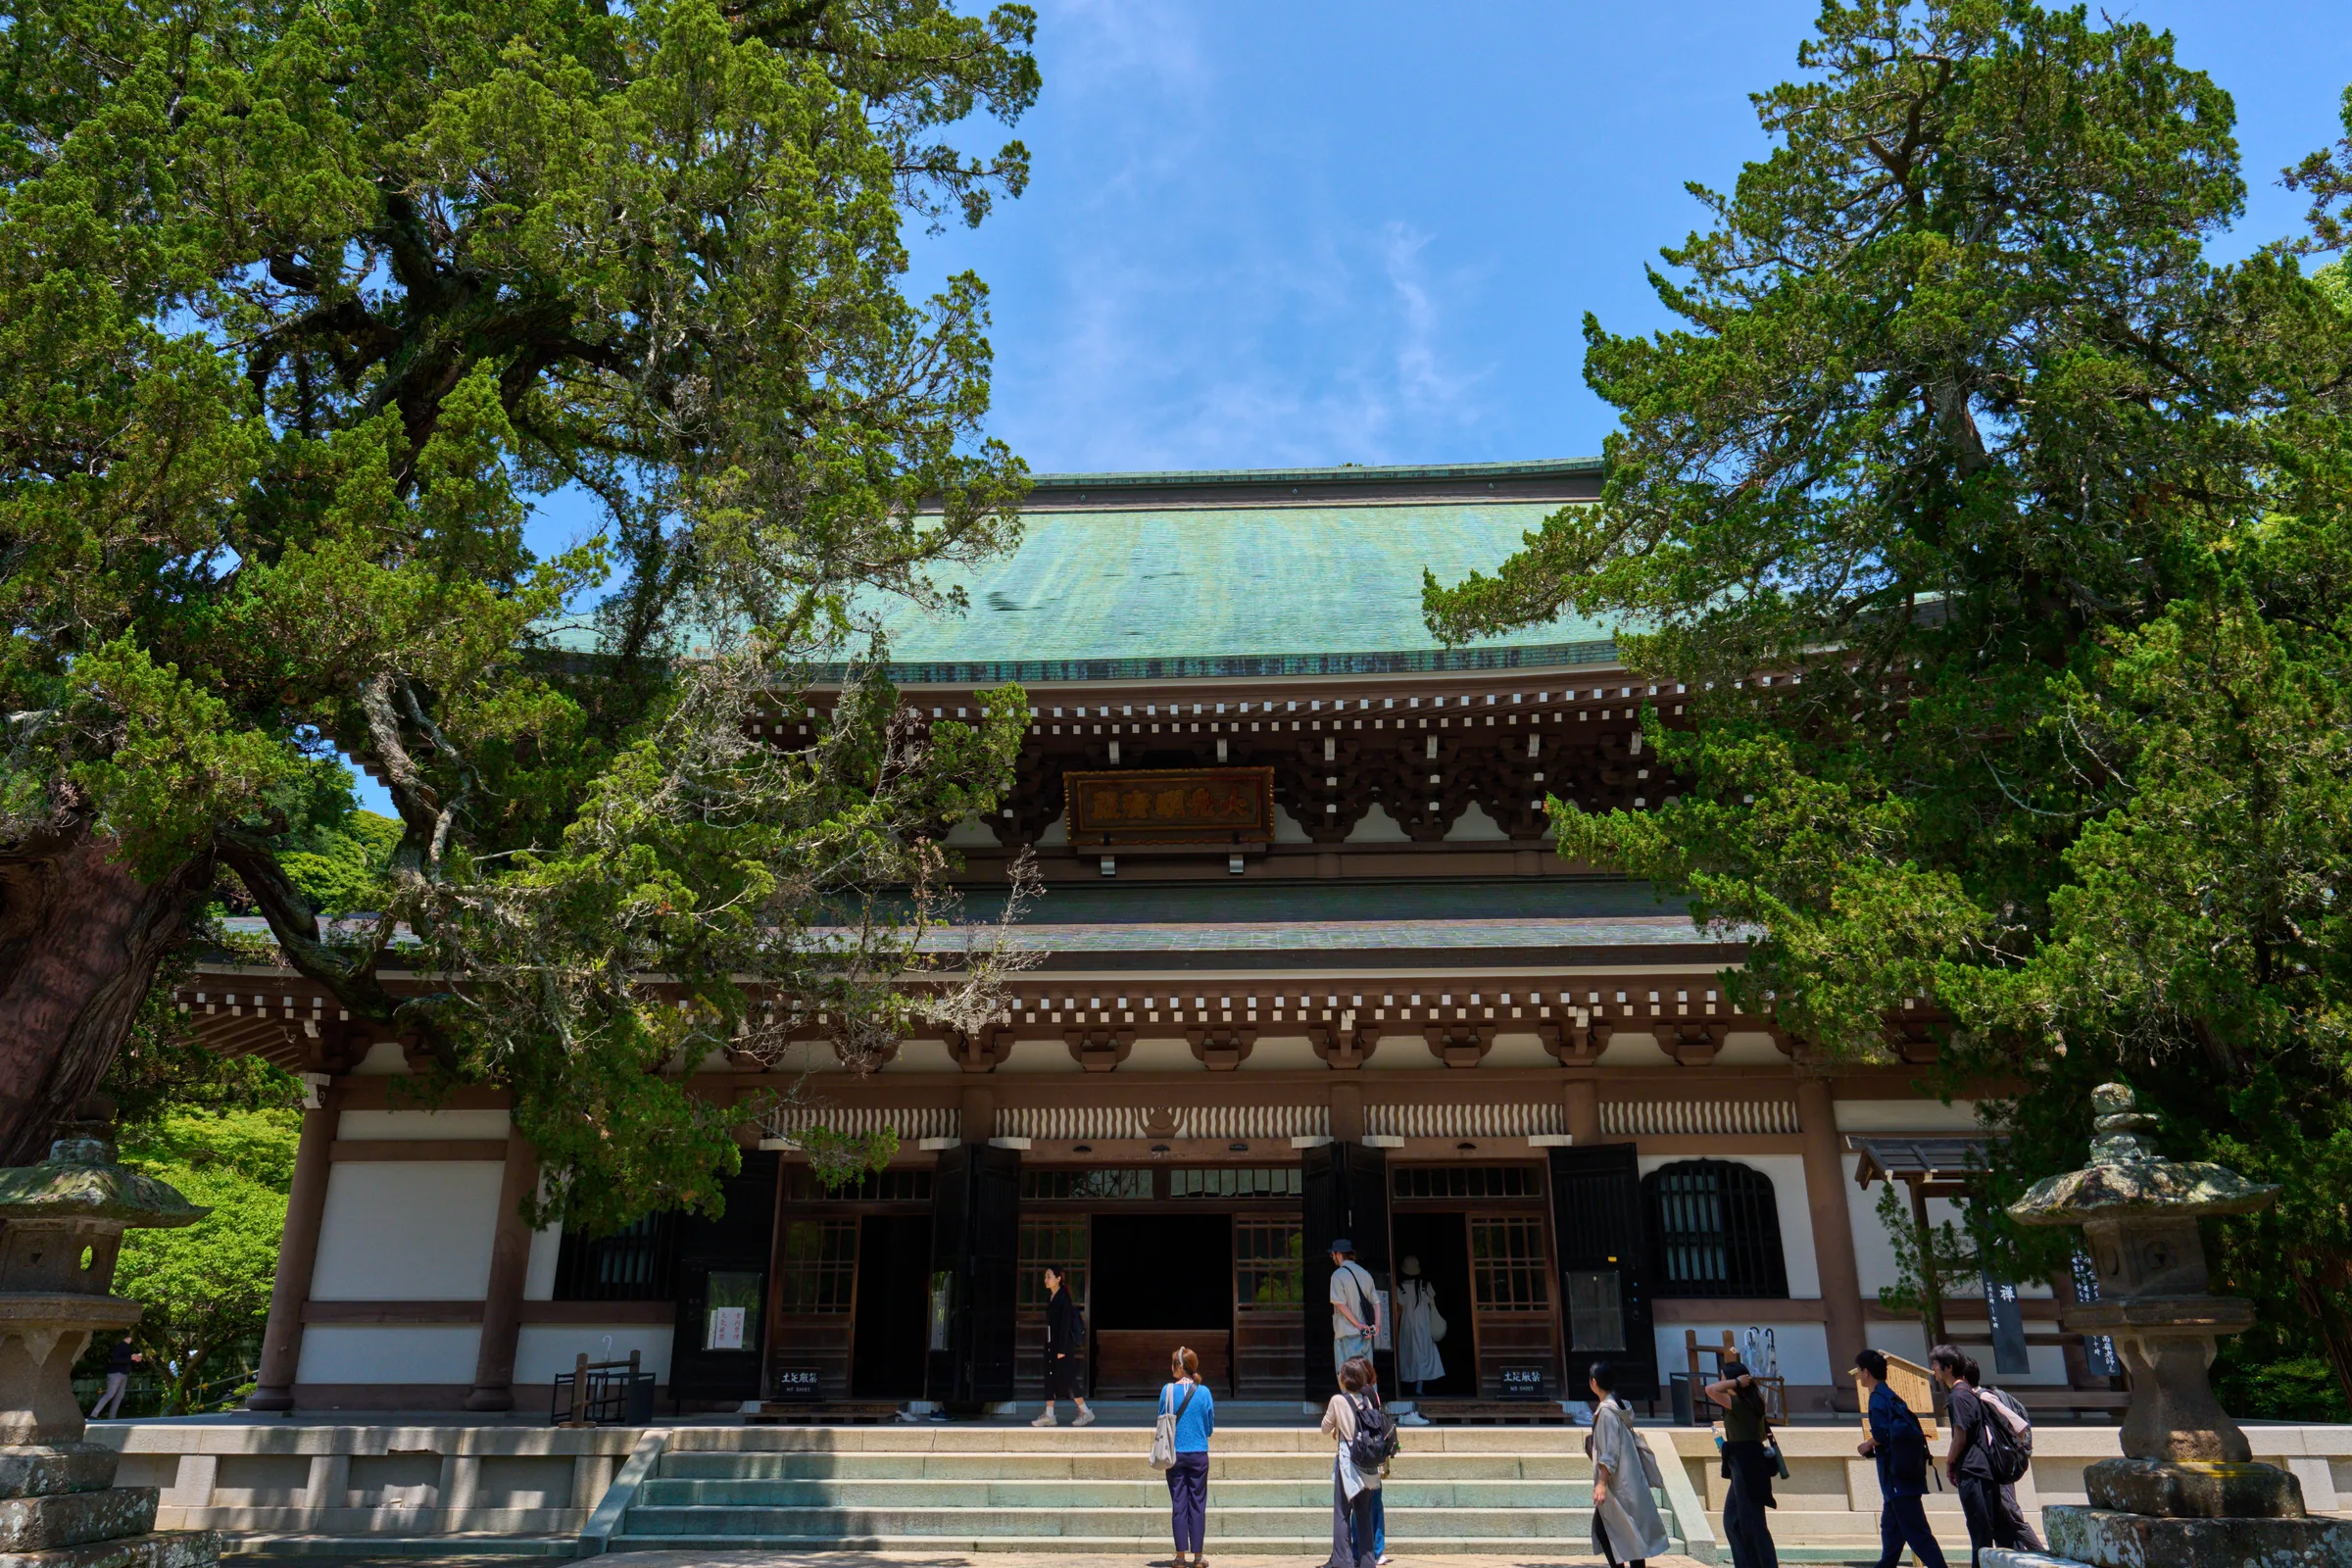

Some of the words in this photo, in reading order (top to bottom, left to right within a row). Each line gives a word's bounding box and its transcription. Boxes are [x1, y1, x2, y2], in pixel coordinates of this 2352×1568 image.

[781, 1372, 817, 1383] 土足厳禁
[1503, 1371, 1541, 1382] 土足厳禁
